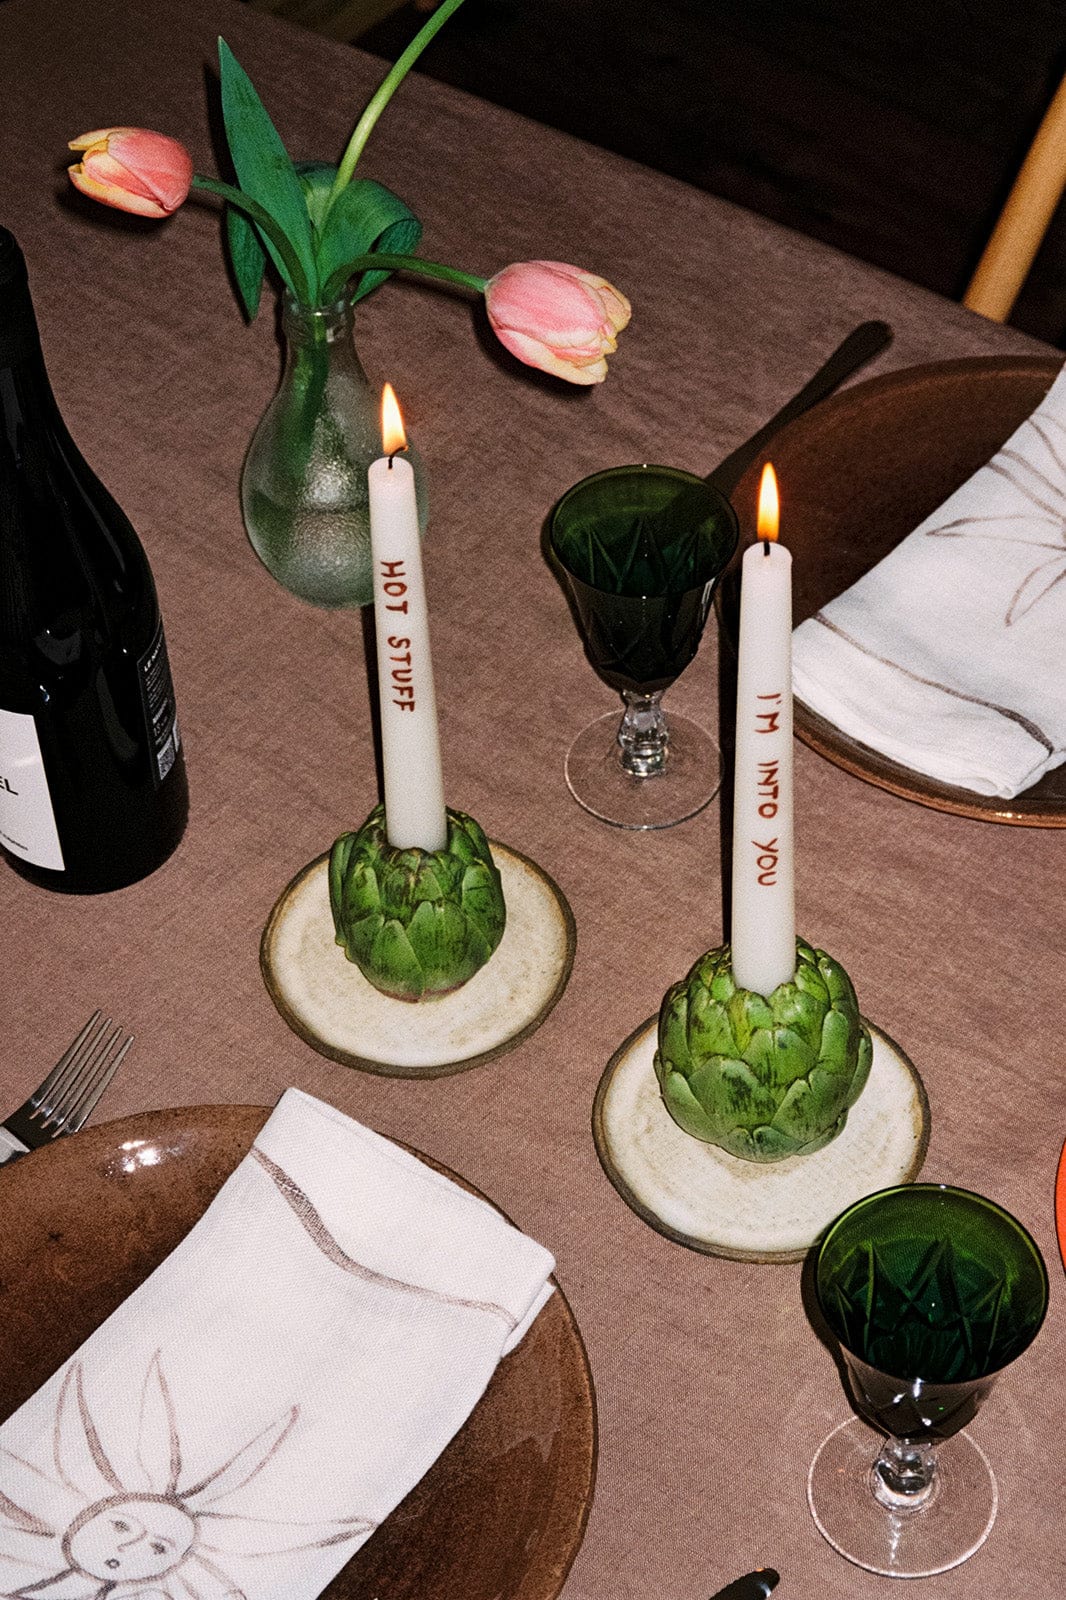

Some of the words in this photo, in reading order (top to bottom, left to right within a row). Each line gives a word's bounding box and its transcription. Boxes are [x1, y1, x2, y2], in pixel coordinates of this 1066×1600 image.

[380, 561, 408, 615] HOT
[387, 636, 415, 712] STUFF
[754, 693, 782, 734] I'M
[756, 760, 779, 819] INTO
[750, 837, 779, 887] YOU
